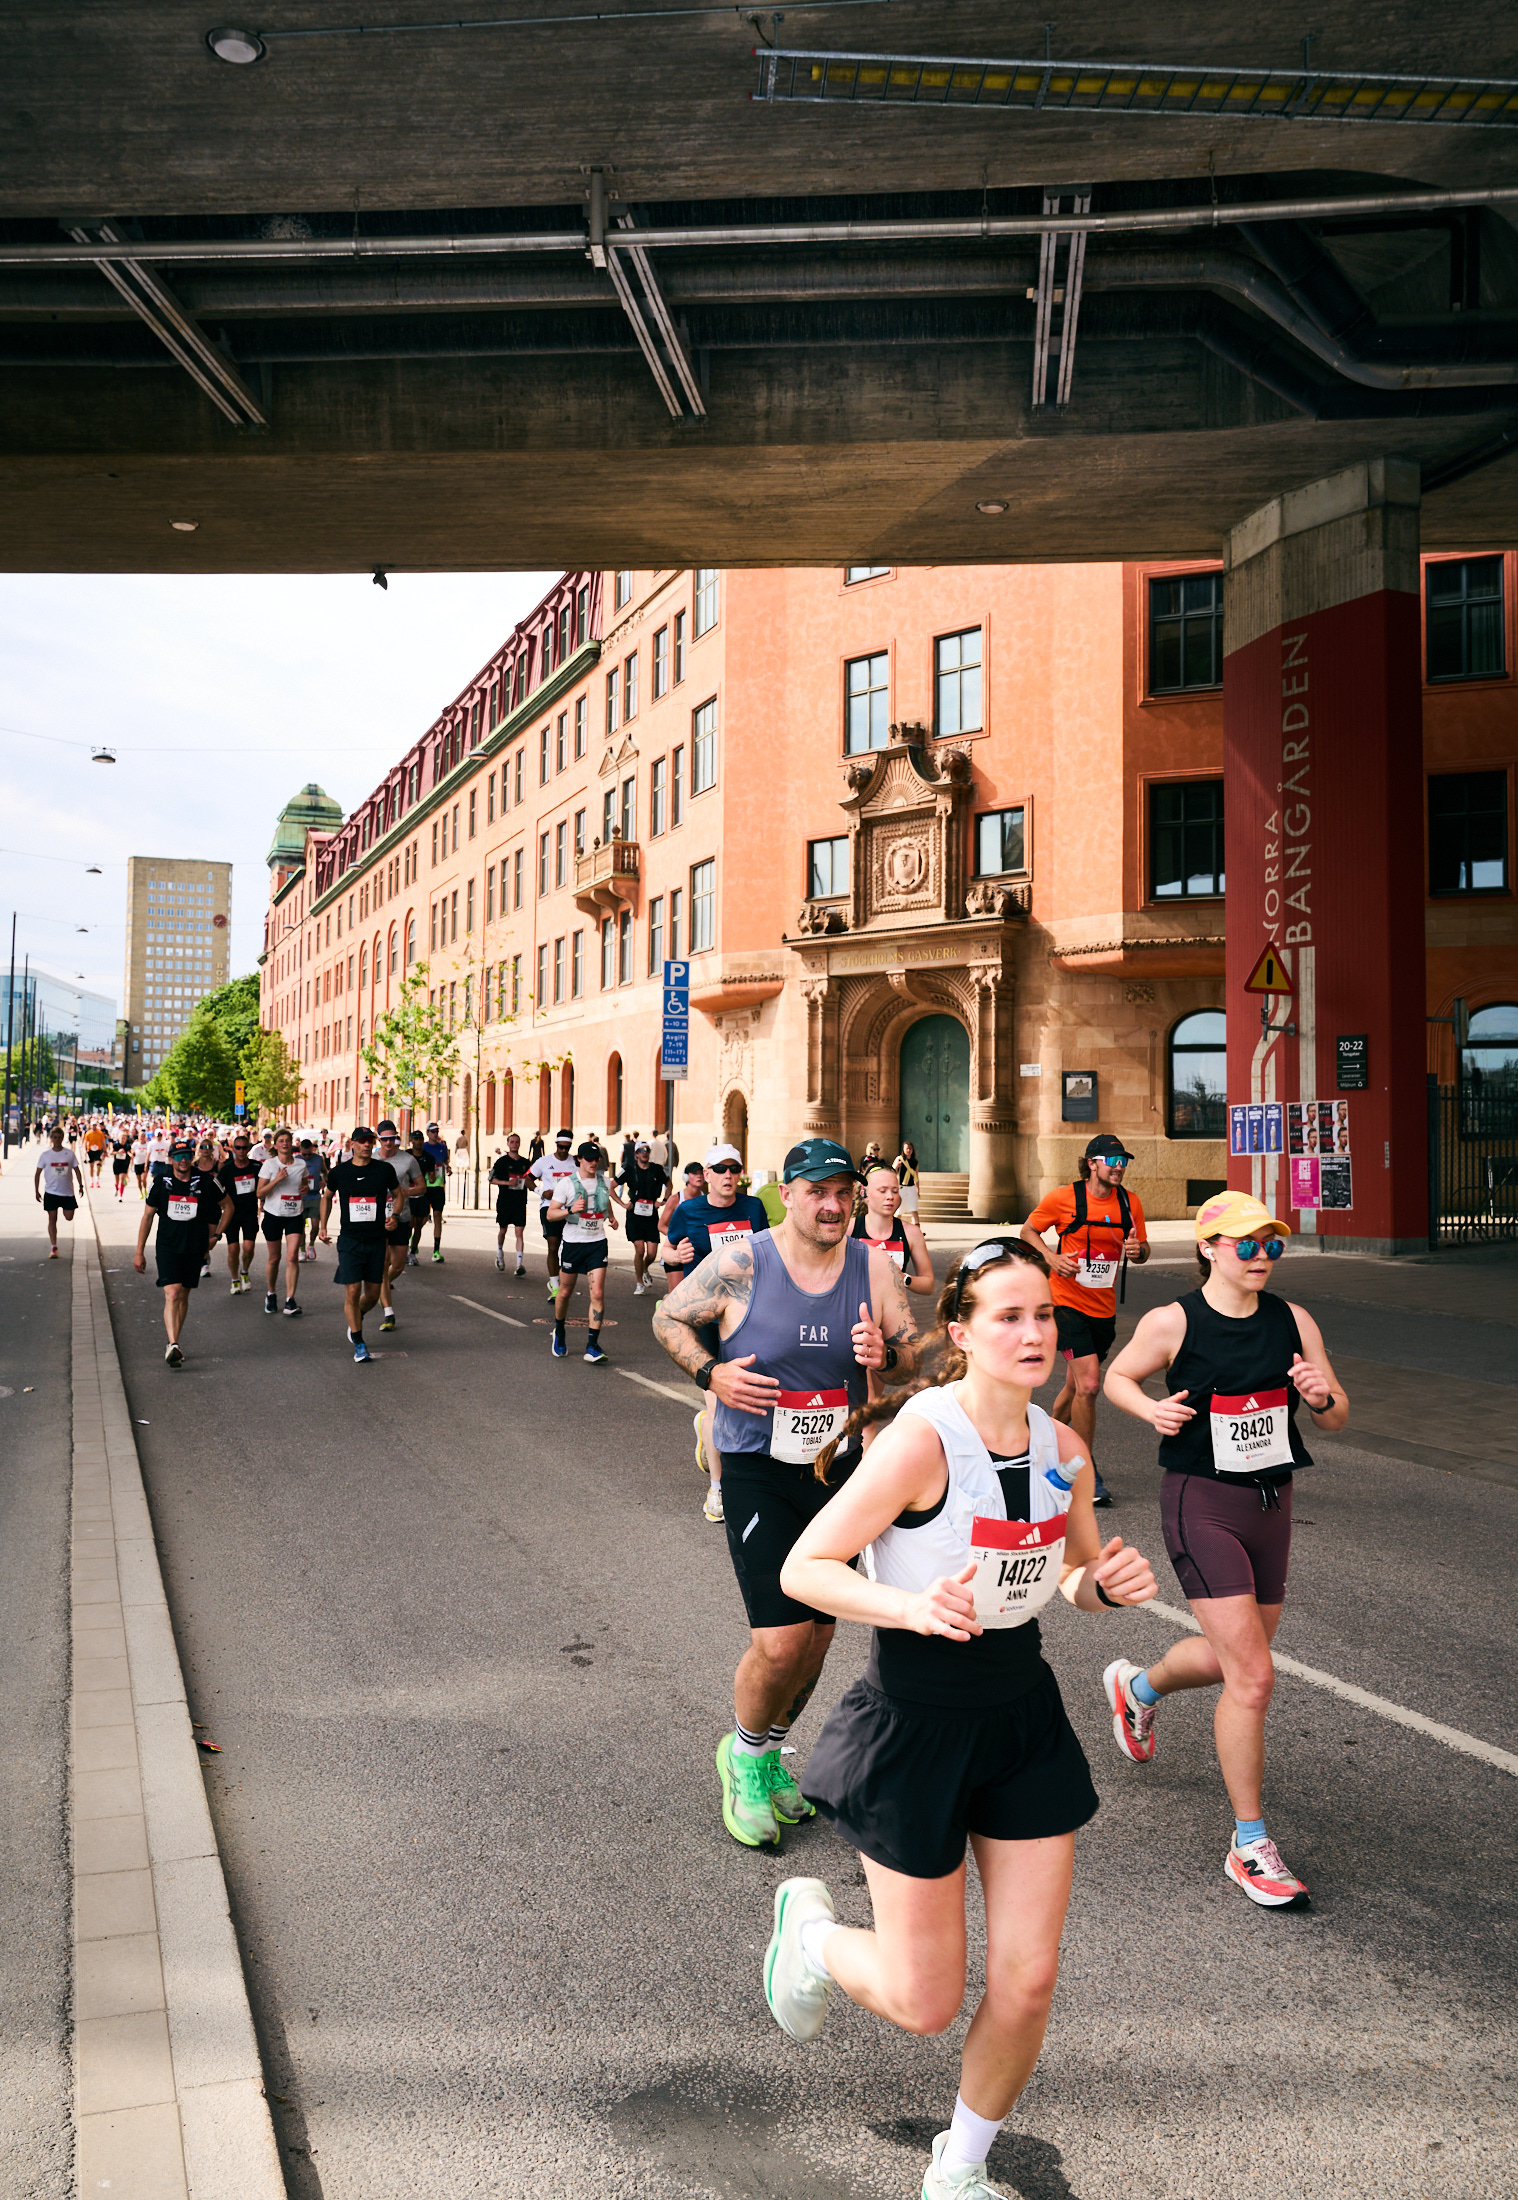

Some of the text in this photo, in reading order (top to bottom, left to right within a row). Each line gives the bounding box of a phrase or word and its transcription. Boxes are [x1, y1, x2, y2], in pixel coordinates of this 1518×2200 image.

[1277, 632, 1312, 943] BANGÅRDEN
[1262, 810, 1279, 946] NORRA
[841, 951, 904, 968] STOCKHOLMS
[670, 963, 685, 985] P
[1339, 1041, 1363, 1051] 20-22
[1086, 1263, 1110, 1273] 22350
[799, 1324, 829, 1341] FAR
[791, 1413, 834, 1434] 25229
[1230, 1415, 1273, 1440] 28420
[802, 1436, 822, 1445] TOBIAS
[1236, 1438, 1272, 1452] ALEXANDRA
[997, 1555, 1047, 1587] 14122
[1006, 1588, 1028, 1601] ANNA
